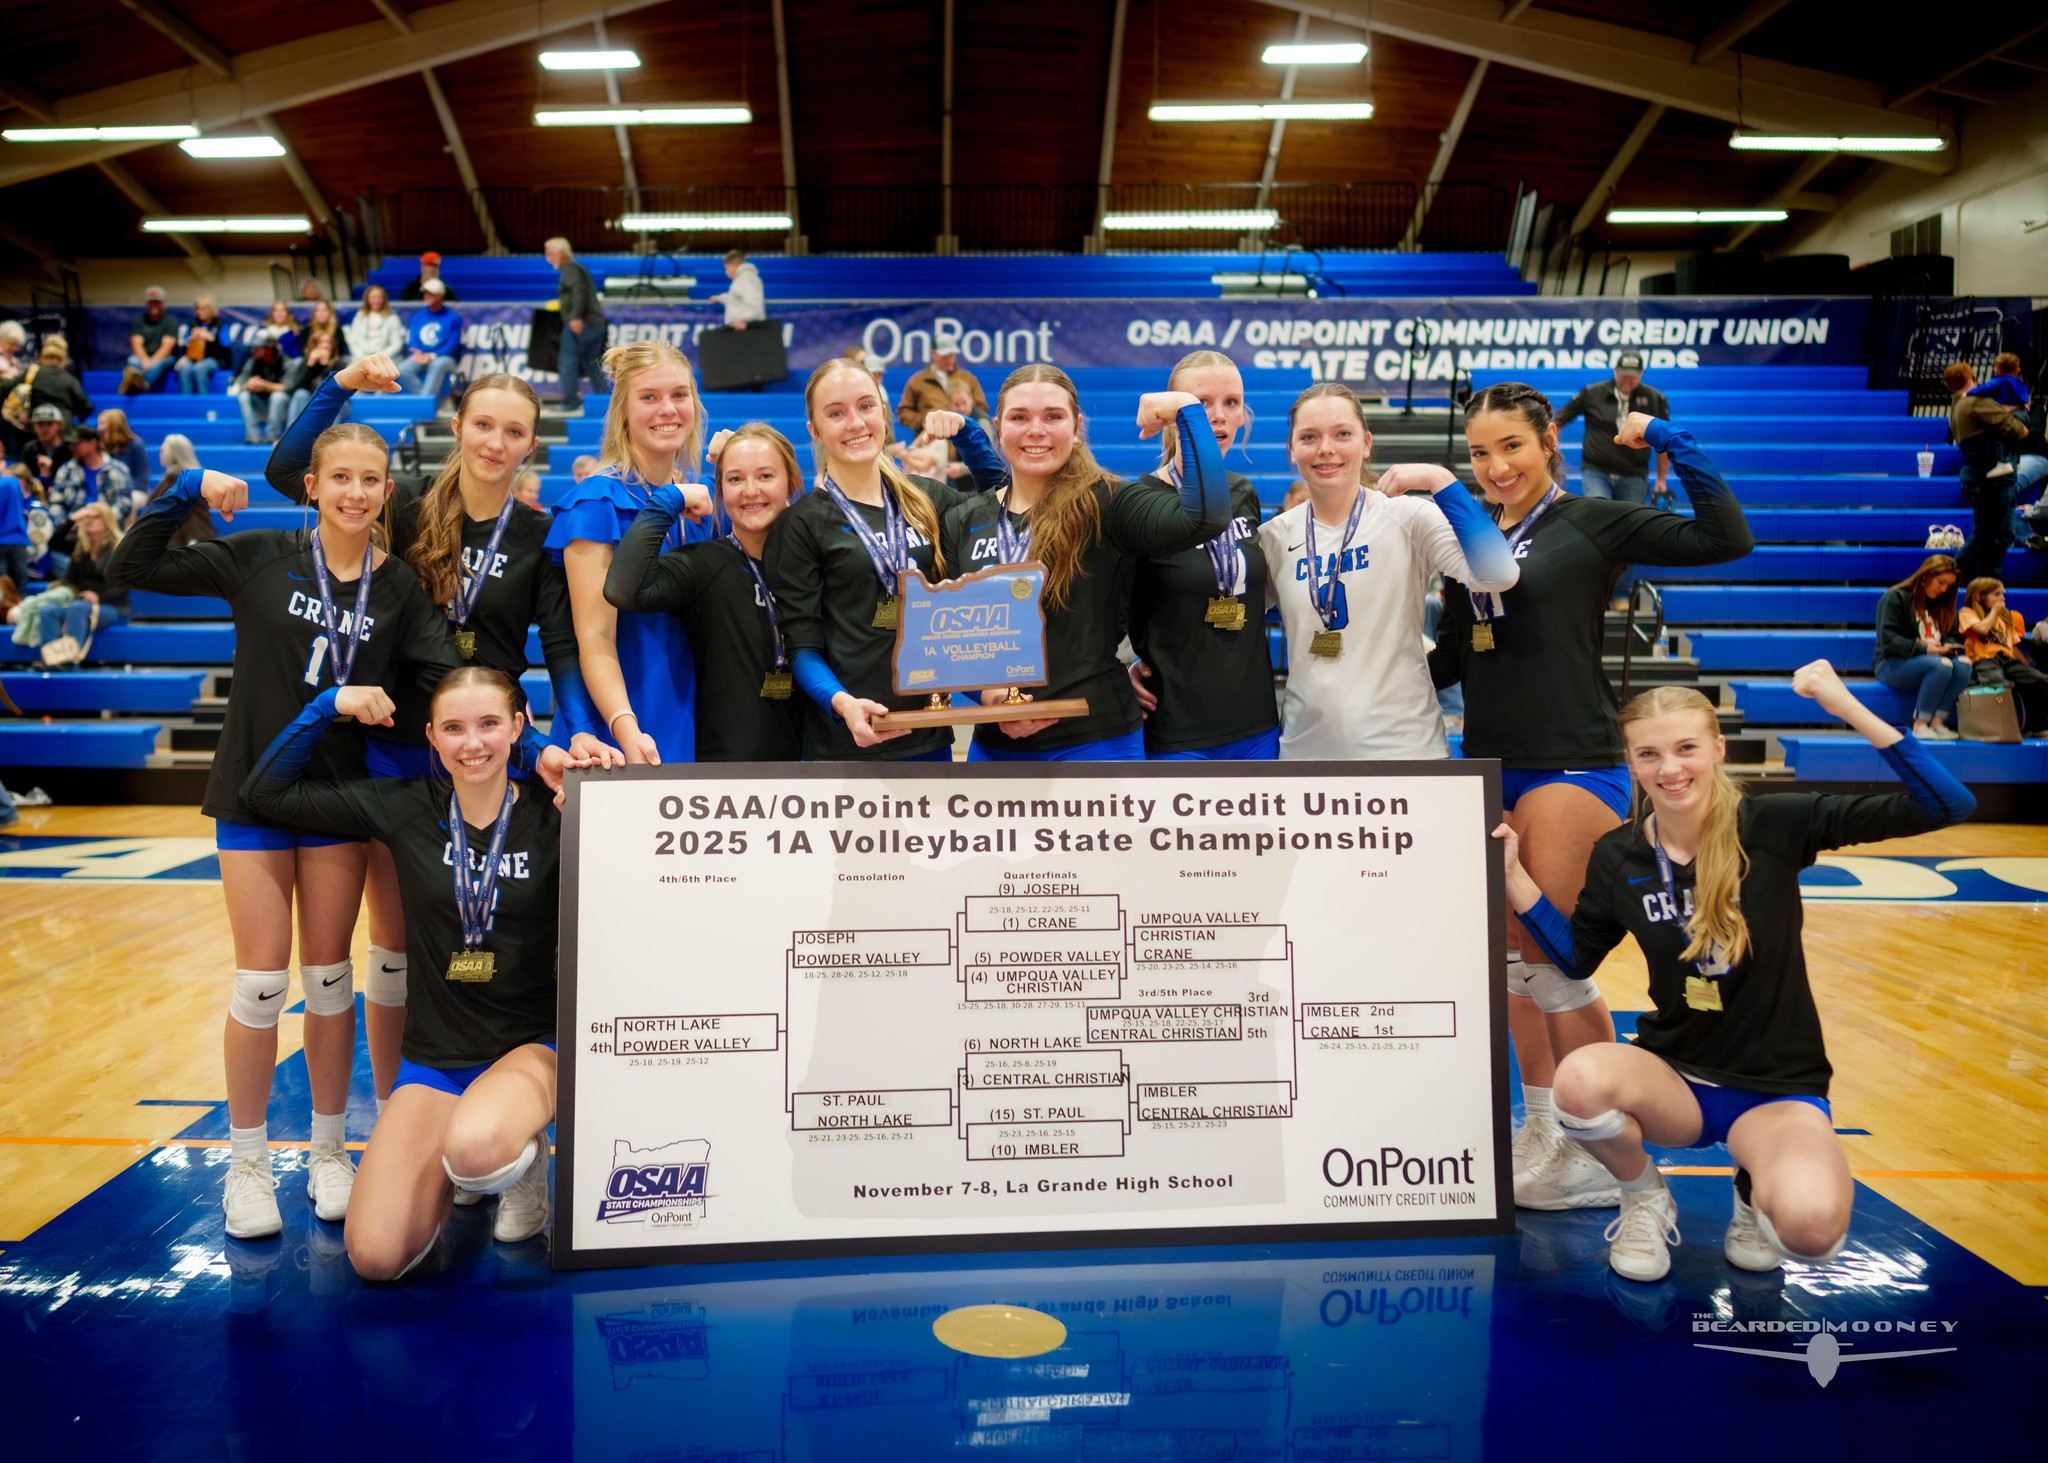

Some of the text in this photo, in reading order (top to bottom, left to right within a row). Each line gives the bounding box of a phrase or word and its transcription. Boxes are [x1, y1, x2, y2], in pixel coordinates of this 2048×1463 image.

[1127, 320, 1216, 346] OSAA
[1245, 319, 1391, 346] ONPOINT
[1394, 319, 1596, 346] COMMUNITY
[1598, 318, 1720, 346] CREDIT
[1723, 317, 1829, 345] UNION
[863, 317, 1053, 363] OnPoint
[1374, 349, 1700, 381] CHAMPIONSIPS
[1296, 544, 1369, 581] CRANE
[930, 604, 1010, 635] OSAA
[924, 641, 1020, 656] 1A VOLLEYBALL
[304, 635, 329, 687] 1
[951, 653, 995, 662] CHAMPION
[1006, 665, 1035, 674] OnPoint
[658, 792, 1409, 823] OSAA/OnPoint Community Credit Union
[655, 826, 1413, 859] 2025 1A Volleyball State Championship
[659, 874, 737, 884] 4th/6th Place
[838, 873, 905, 882] Consolation
[1003, 871, 1078, 880] Quarterfinals
[1179, 869, 1237, 878] Semifinals
[1360, 869, 1388, 878] Final
[998, 883, 1080, 897] (9) JOSEPH
[989, 905, 1090, 914] 25-18, 25-12, 22-25, 25-11
[1642, 889, 1694, 922] CRA
[1002, 917, 1077, 931] (1) CRANE
[1141, 912, 1259, 924] UMPQUA VALLEY
[797, 932, 855, 944] JOSEPH
[1140, 930, 1216, 941] CHRISTIAN
[797, 952, 920, 965] POWDER VALLEY
[974, 951, 1121, 965] (5) POWDER VALLEY
[1144, 949, 1193, 960] CRANE
[451, 960, 483, 972] OSAA
[1136, 963, 1161, 971] 25-20,
[1189, 962, 1213, 970] 25-14,
[831, 971, 856, 979] 28-26,
[971, 969, 1116, 984] (4) UMPQUA VALLEY
[1007, 981, 1083, 994] CHRISTIAN
[1138, 989, 1178, 997] 3rd/5th
[1248, 992, 1269, 1003] 3rd
[1037, 1001, 1062, 1009] 27-29,
[1307, 1006, 1394, 1017] IMBLER 2nd
[1090, 1006, 1288, 1021] UMPQUA VALLEY CHRISTIAN
[590, 1018, 721, 1033] 6th NORTH LAKE
[1311, 1025, 1394, 1038] CRANE 1st
[1091, 1027, 1267, 1040] CENTRAL CHRISTIAN 5th
[590, 1037, 751, 1053] 4th POWDER VALLEY
[964, 1037, 1082, 1051] (6) NORTH LAKE
[629, 1057, 709, 1067] 25-18, 25-19, 25-12
[1012, 1060, 1032, 1068] 25-8,
[983, 1074, 1050, 1085] CENTRAL
[1055, 1072, 1130, 1084] CHRISTIAN
[1144, 1086, 1197, 1097] IMBLER
[823, 1094, 885, 1106] ST. PAUL
[989, 1107, 1085, 1122] (15) ST. PAUL
[1142, 1104, 1288, 1120] CENTRAL CHRISTIAN
[818, 1114, 912, 1127] NORTH LAKE
[1152, 1122, 1176, 1130] 25-15,
[836, 1134, 861, 1142] 23-25,
[999, 1130, 1023, 1138] 25-23,
[1053, 1129, 1075, 1137] 25-15
[991, 1143, 1079, 1158] (10) IMBLER
[1323, 1147, 1475, 1187] OnPoint
[608, 1164, 708, 1199] OSAA
[854, 1175, 1233, 1199] November 7-8, La Grande High School
[606, 1197, 703, 1210] STATE CHAMPIONSHIPS
[1324, 1192, 1476, 1208] COMMUNITY CREDIT UNION
[651, 1212, 692, 1223] OnPoint
